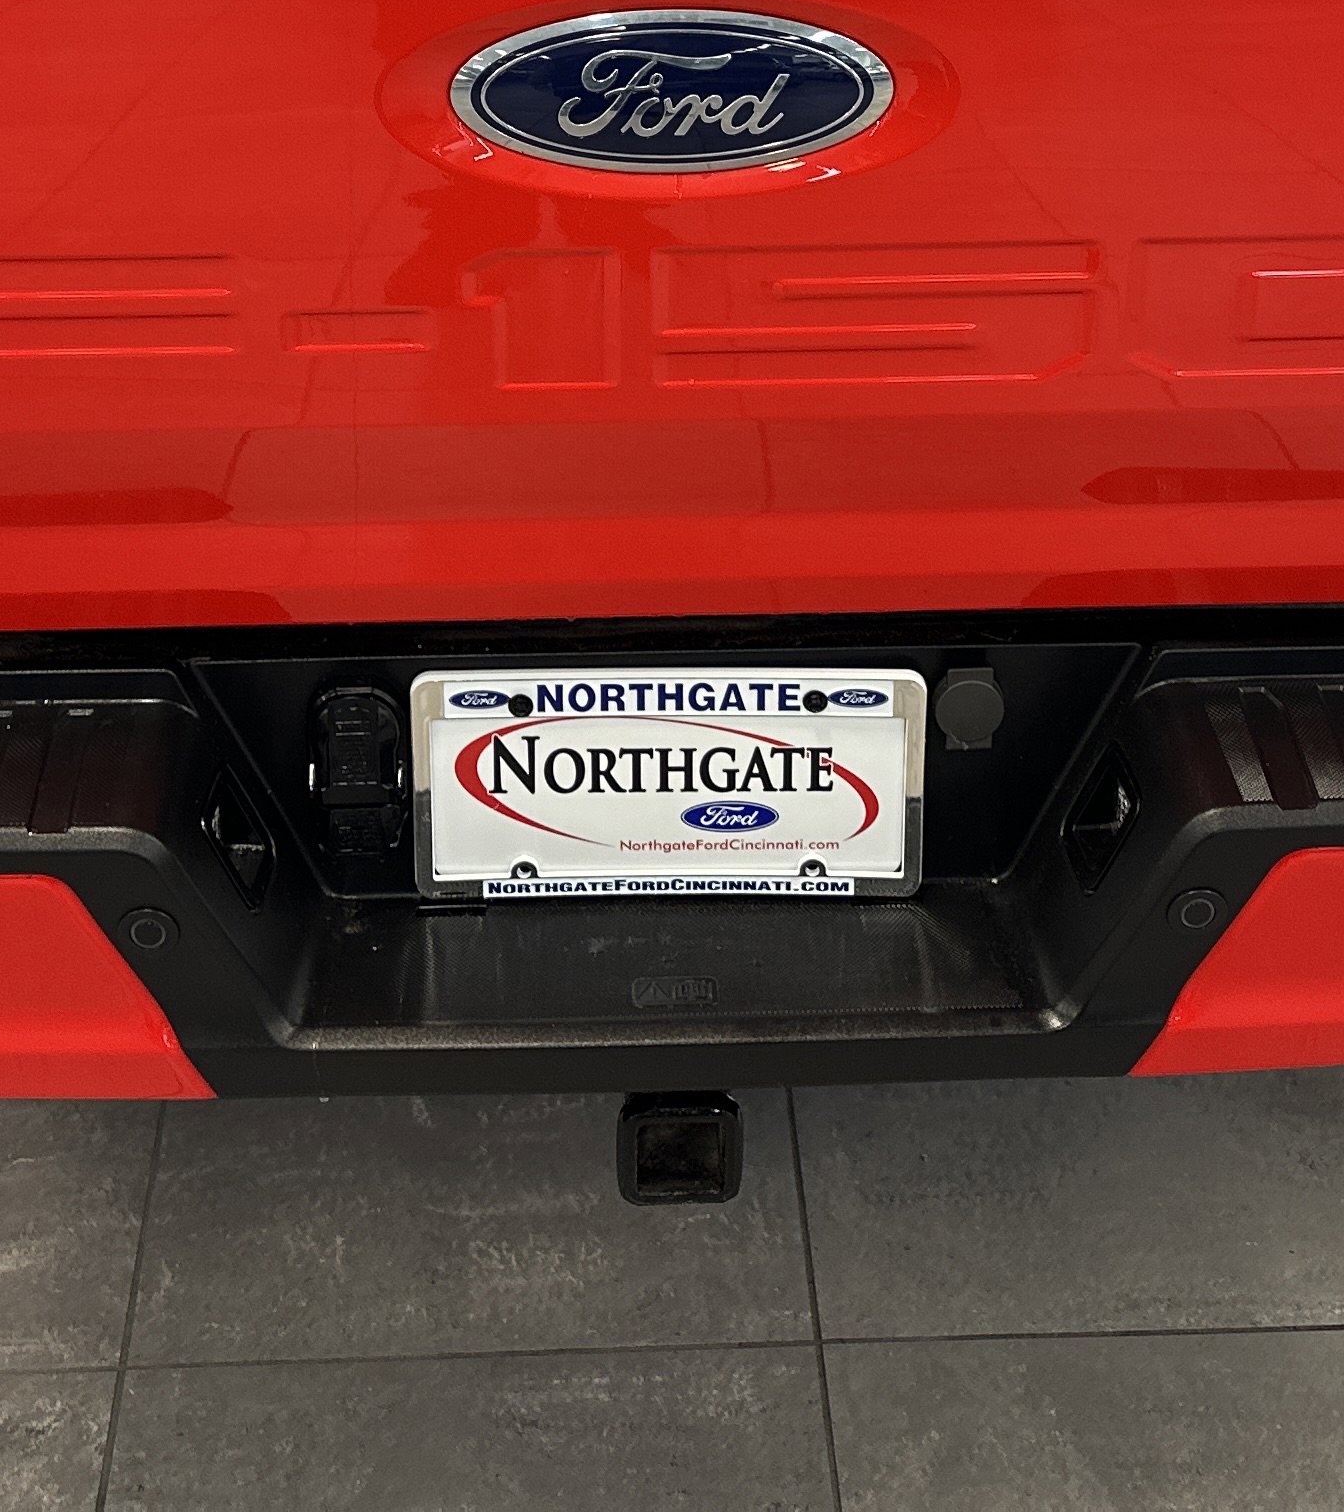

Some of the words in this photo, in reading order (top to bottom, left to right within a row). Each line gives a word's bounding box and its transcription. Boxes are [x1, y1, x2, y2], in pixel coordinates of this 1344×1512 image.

[557, 49, 790, 138] Ford
[460, 691, 498, 707] Ford
[535, 682, 802, 713] NORTHGATE
[838, 689, 877, 705] Ford
[488, 734, 834, 795] NORTHGATE
[698, 804, 760, 827] Ford
[619, 838, 840, 853] NorthgateFordCincinnati.com
